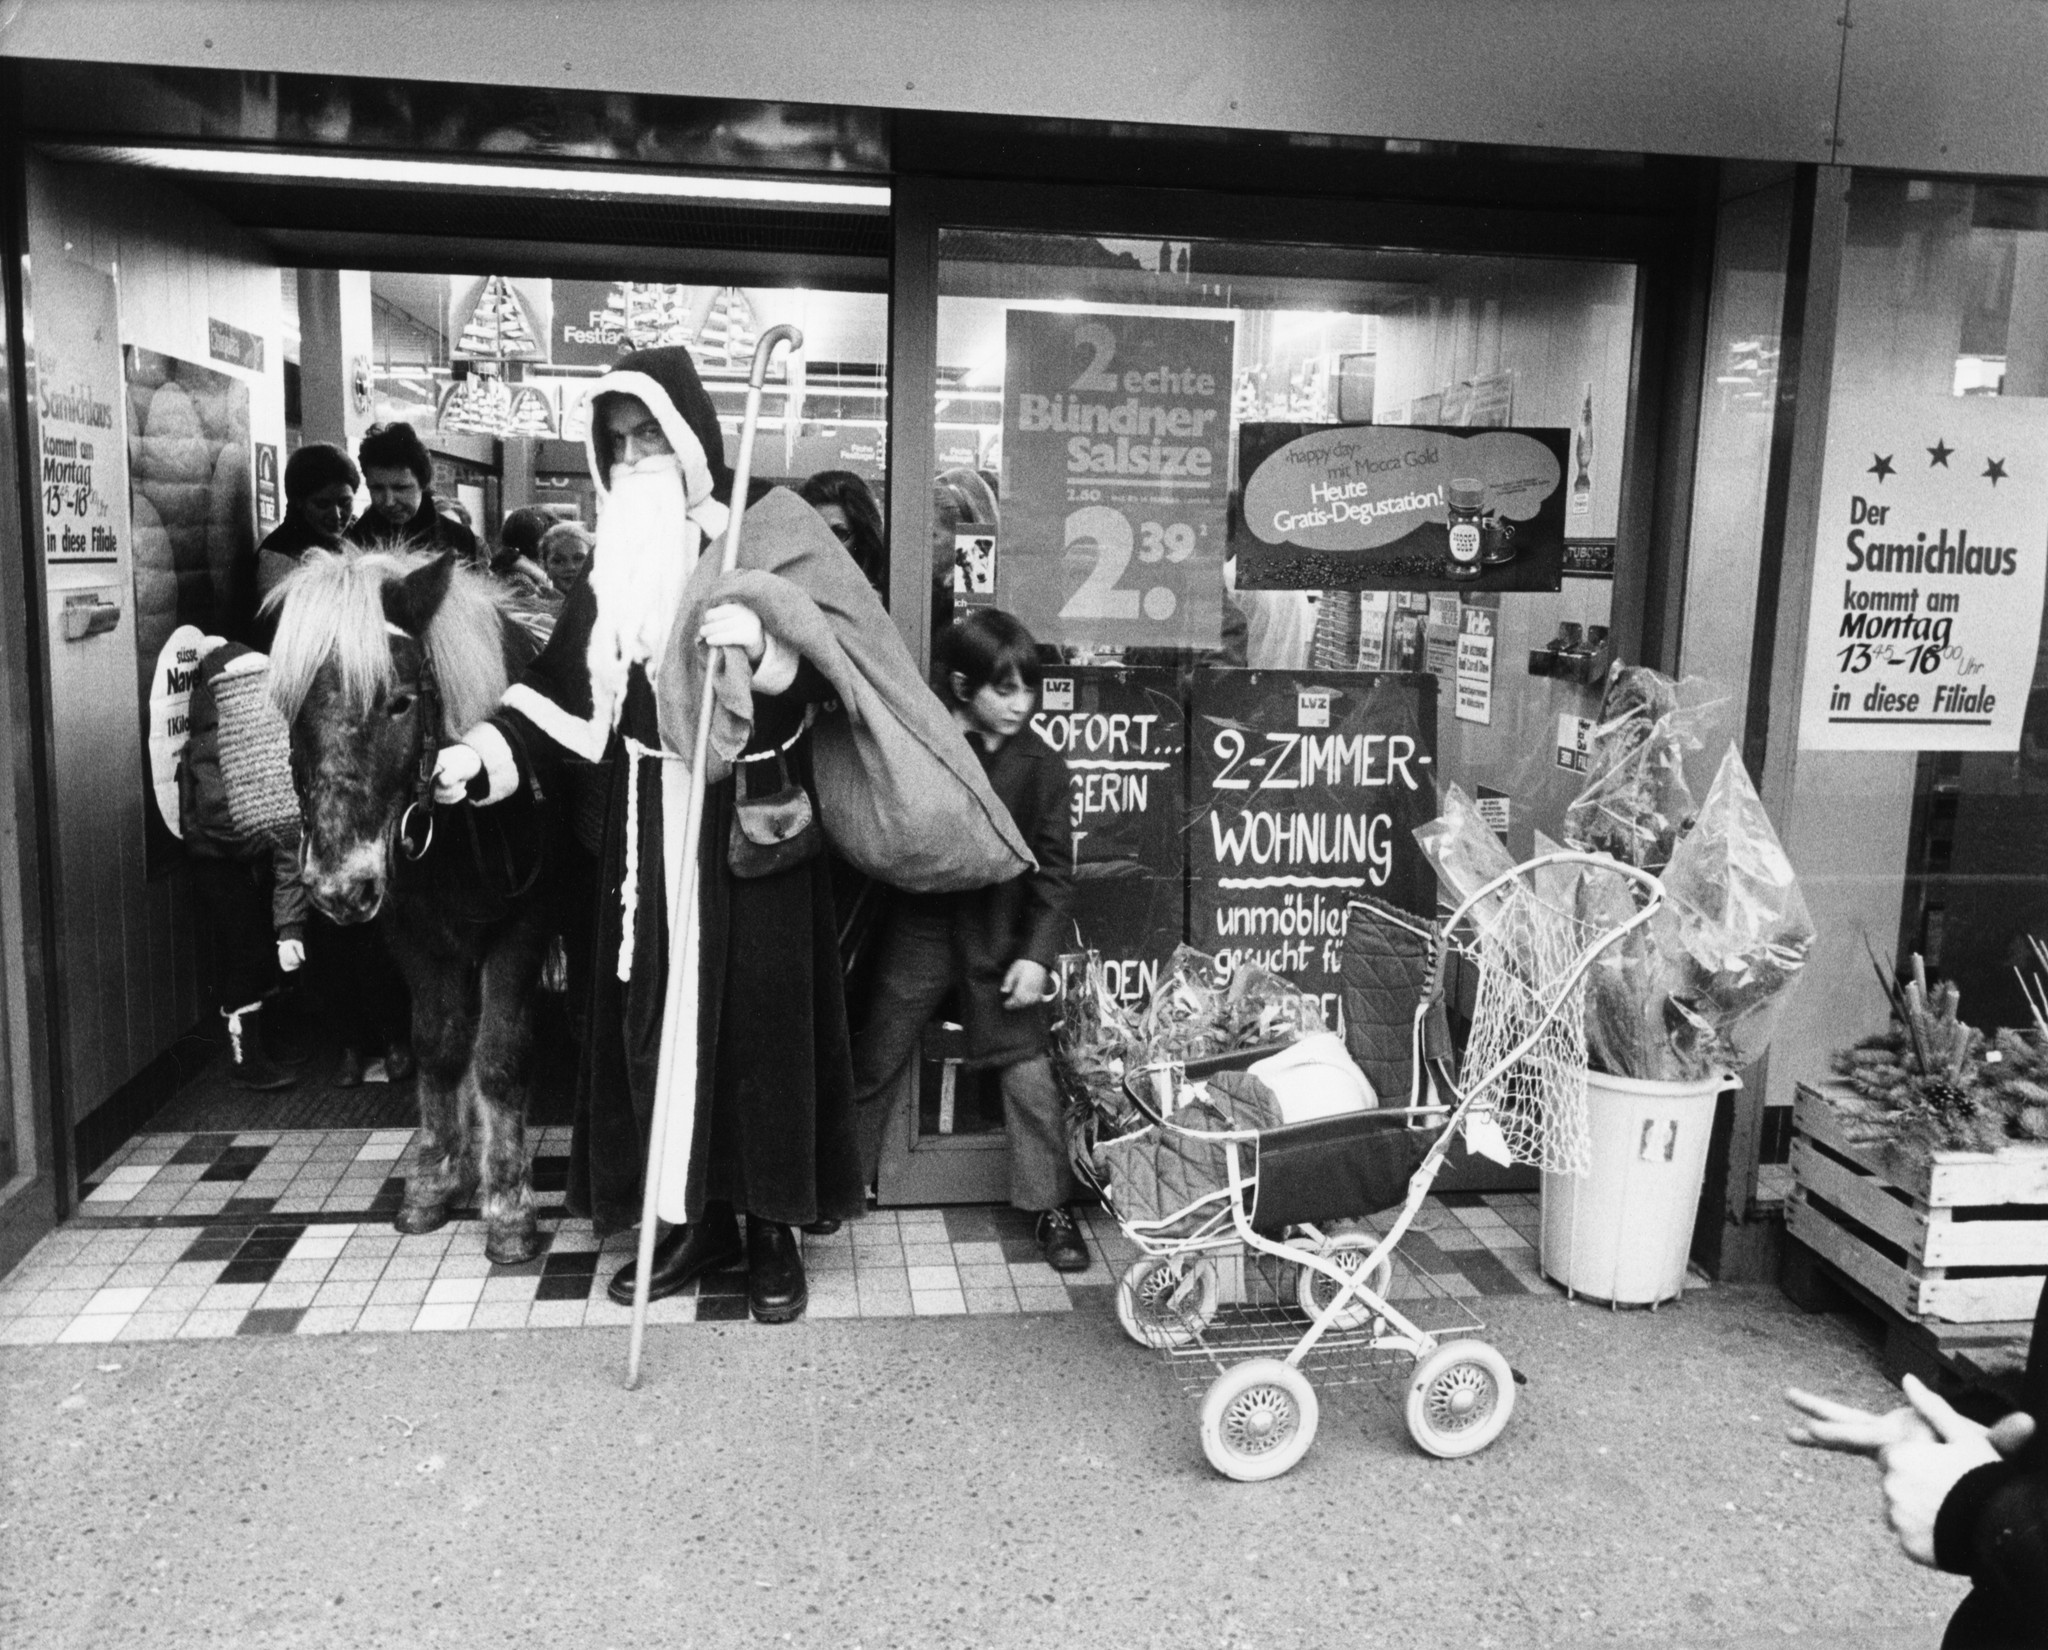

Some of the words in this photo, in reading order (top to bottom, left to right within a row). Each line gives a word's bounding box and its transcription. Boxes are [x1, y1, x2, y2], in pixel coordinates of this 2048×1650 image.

[563, 325, 625, 346] Festta
[1070, 322, 1118, 393] 2
[1123, 365, 1216, 396] echte
[40, 377, 113, 431] Samichlaus
[1018, 393, 1218, 438] Bündner
[42, 425, 77, 459] kommt
[80, 441, 95, 461] am
[1066, 436, 1214, 476] Salsize
[43, 457, 92, 498] Montag
[1328, 464, 1352, 479] mit
[1354, 457, 1402, 476] Mocca
[1404, 448, 1439, 468] Gold
[1273, 484, 1445, 532] Gratis-Degustation!
[1310, 481, 1368, 504] Heute
[1850, 495, 1891, 526] Der
[46, 526, 57, 552] in
[62, 524, 86, 553] diese
[91, 525, 118, 553] Filiale
[1846, 527, 2018, 576] Samichlaus
[1843, 579, 1920, 613] kommt
[1926, 590, 1961, 613] am
[1465, 610, 1492, 636] Tele
[1839, 612, 1954, 653] Montag
[176, 647, 199, 665] süsse
[1045, 681, 1071, 693] LVZ
[1301, 698, 1328, 710] LVZ
[1830, 684, 1852, 712] in
[1863, 682, 1920, 713] diese
[1932, 684, 1997, 714] Filiale
[1212, 729, 1433, 791] 2-ZIMMER-
[1210, 810, 1393, 887] WOHNUNG
[1216, 893, 1349, 937] unmöblier
